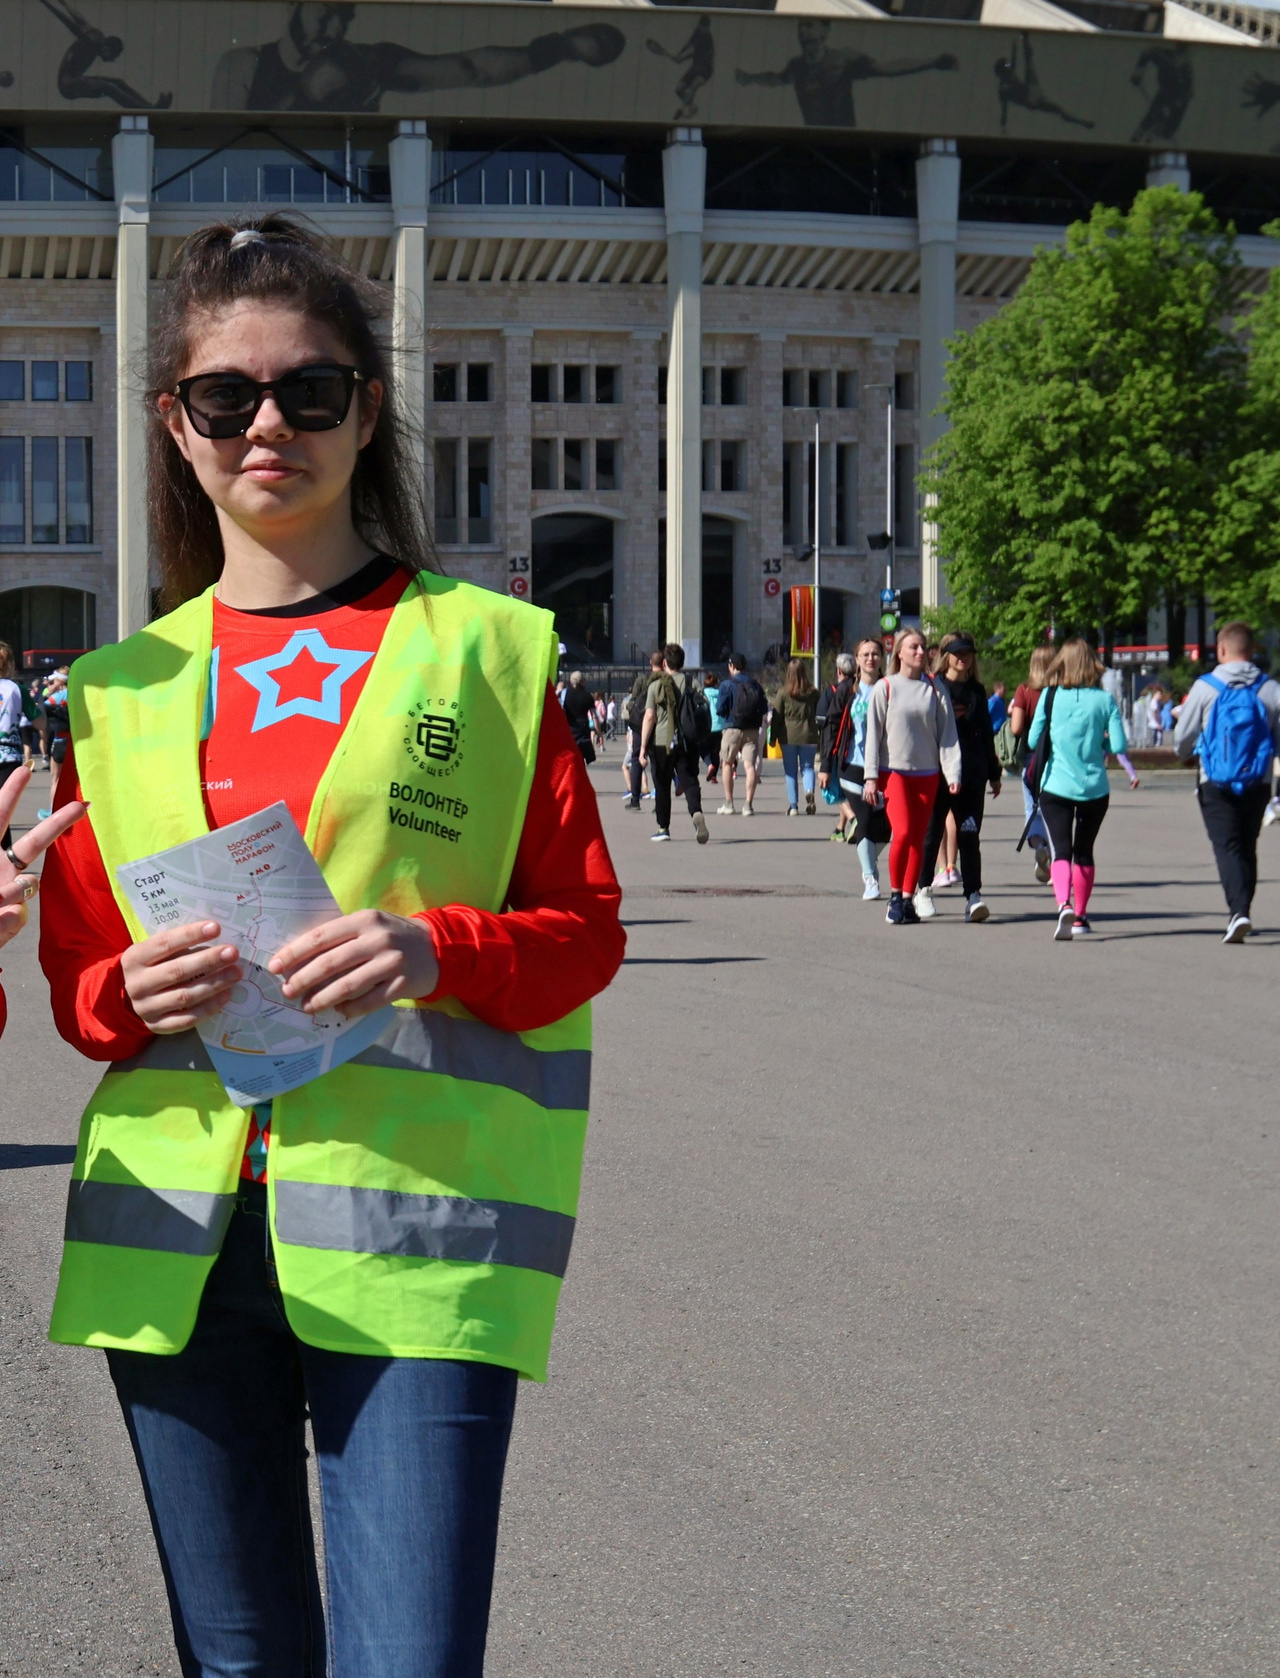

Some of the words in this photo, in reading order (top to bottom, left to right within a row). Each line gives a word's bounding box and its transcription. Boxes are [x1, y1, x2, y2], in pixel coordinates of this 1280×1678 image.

[509, 557, 529, 573] 13
[763, 558, 782, 574] 13
[389, 781, 469, 820] ВОЛОНТЁР
[389, 805, 462, 844] Volunteer
[227, 821, 283, 852] МОСКОВСКИЙ
[231, 844, 253, 859] ПОЛУ
[235, 843, 276, 866] МАРАФОН
[134, 870, 166, 888] Старт
[141, 891, 149, 902] 5
[150, 888, 166, 900] км
[149, 902, 162, 914] 13
[162, 898, 180, 910] мая
[154, 911, 180, 926] 10:00
